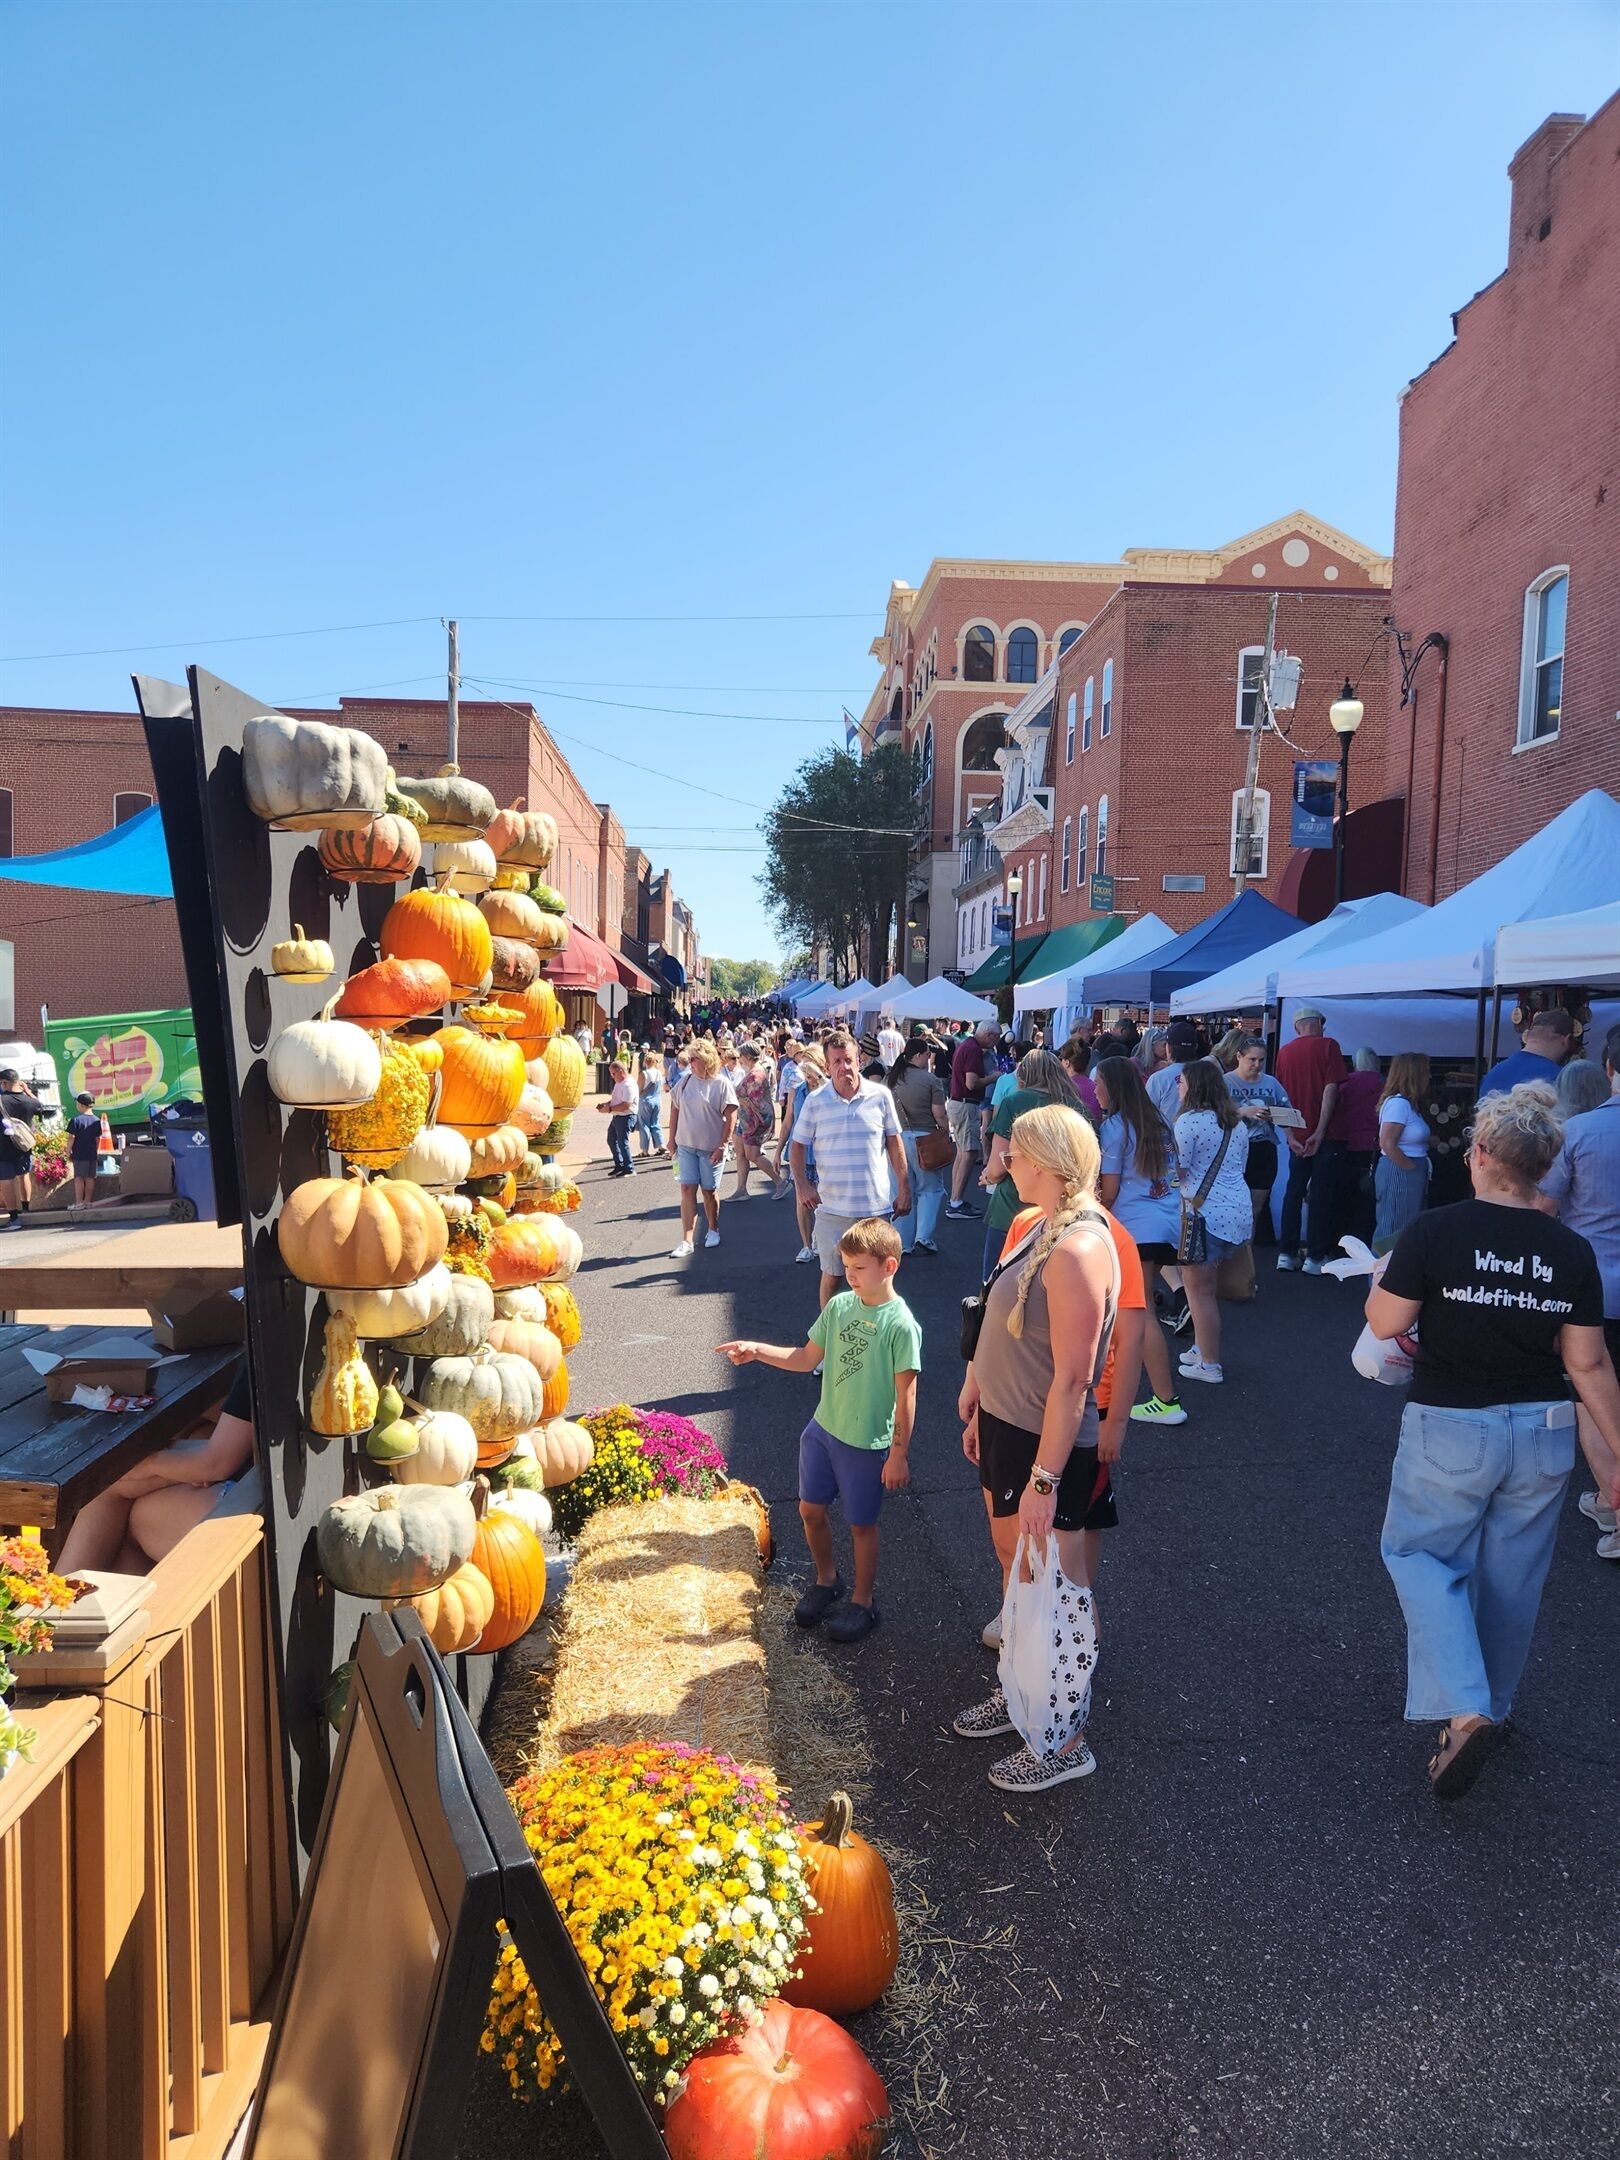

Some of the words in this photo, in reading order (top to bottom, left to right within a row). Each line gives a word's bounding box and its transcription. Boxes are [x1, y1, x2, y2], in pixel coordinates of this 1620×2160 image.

[1297, 770, 1306, 803] WASHINGTON
[1093, 884, 1112, 896] Encore
[84, 1034, 147, 1071] Sun
[85, 1061, 153, 1096] Drop
[1232, 1088, 1273, 1097] DOLLY
[1475, 1250, 1525, 1276] Wired
[1532, 1255, 1553, 1283] By
[1442, 1286, 1573, 1313] waldefirth.com
